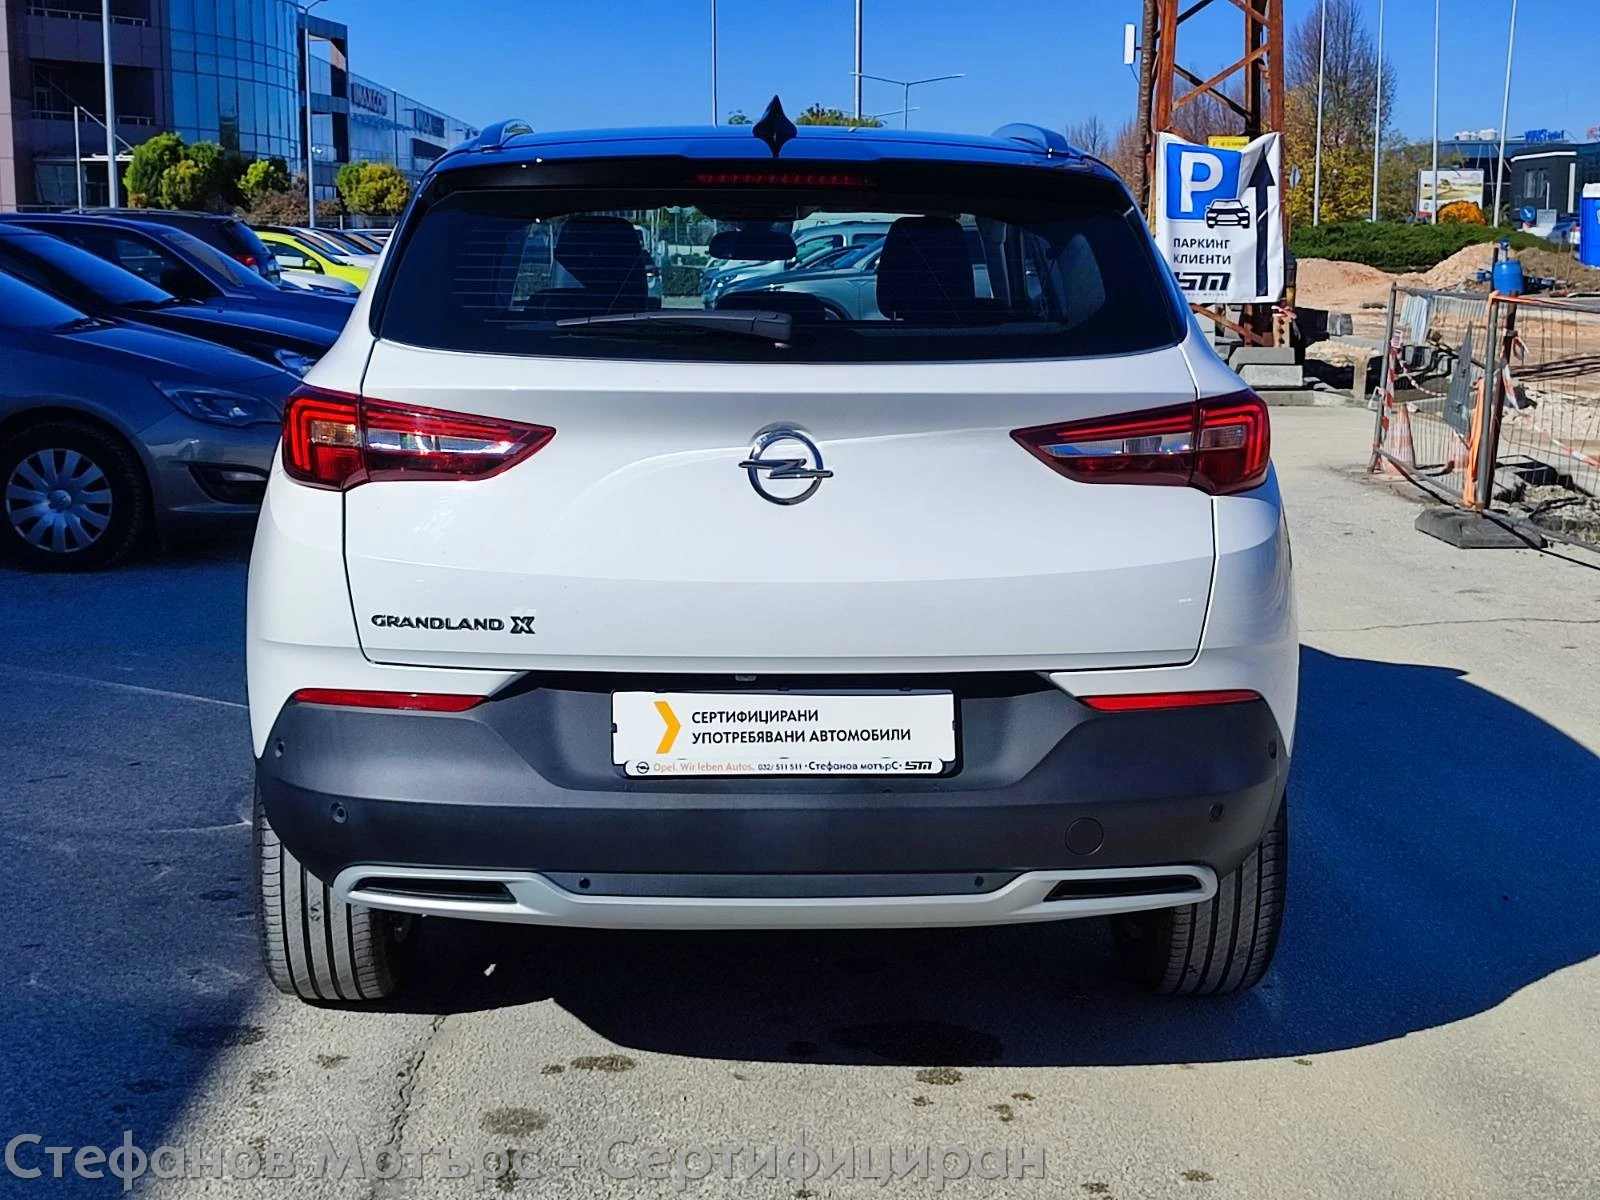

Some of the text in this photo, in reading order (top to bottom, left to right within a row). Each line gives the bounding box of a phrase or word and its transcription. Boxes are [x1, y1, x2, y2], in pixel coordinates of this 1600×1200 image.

[1180, 151, 1223, 213] P
[1173, 238, 1231, 249] ПАРКИНГ
[1173, 253, 1231, 265] КЛИЕНТИ
[371, 614, 536, 635] GRANDLAND X
[691, 709, 819, 725] СЕРТИФИЦИРАНИ
[691, 728, 911, 745] УПОТРЕБЯВАНИ АВТОМОБИЛИ
[680, 762, 696, 771] Wir
[697, 762, 724, 771] leben
